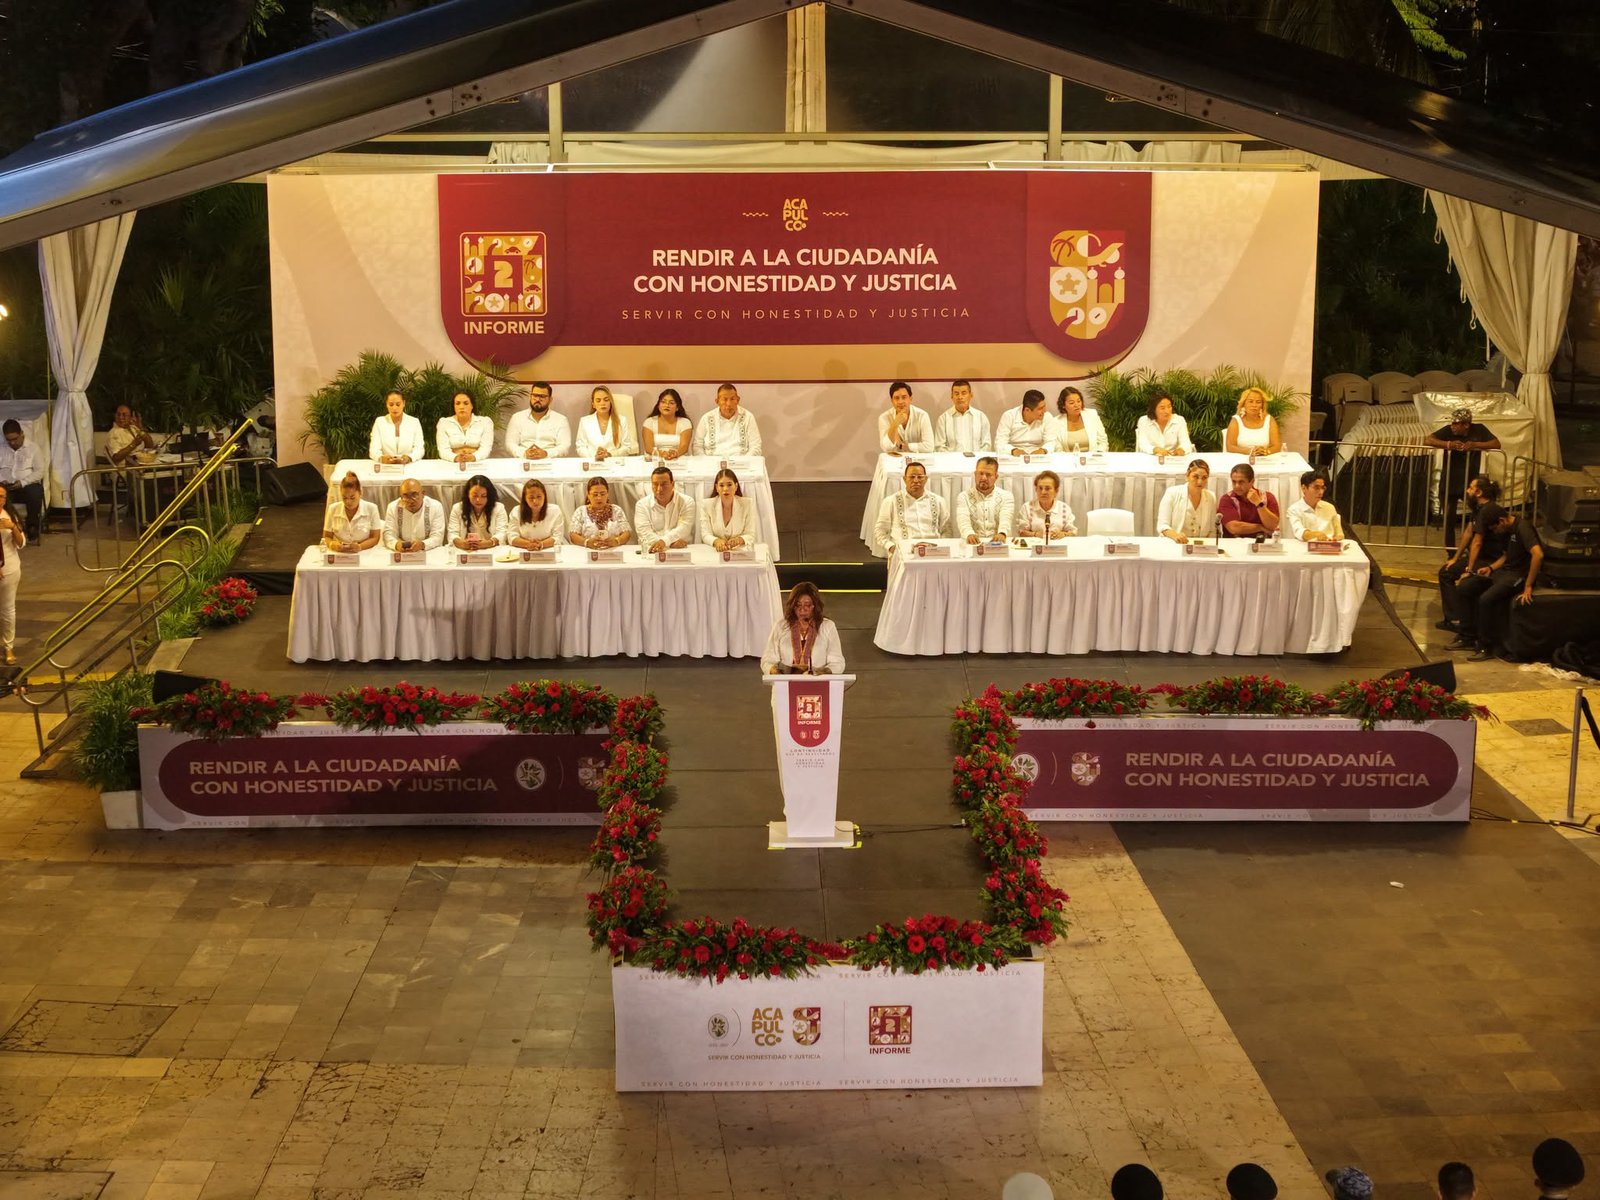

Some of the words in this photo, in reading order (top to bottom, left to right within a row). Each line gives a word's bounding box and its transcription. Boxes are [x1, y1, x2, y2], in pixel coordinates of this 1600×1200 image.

[783, 198, 808, 210] ACA
[783, 209, 808, 221] PUL
[652, 249, 734, 267] RENDIR
[740, 249, 757, 266] A
[763, 248, 790, 266] LA
[796, 243, 938, 265] CIUDADANÍA
[494, 260, 513, 288] 2
[633, 275, 683, 293] CON
[691, 274, 836, 292] HONESTIDAD
[842, 274, 857, 291] Y
[862, 273, 957, 291] JUSTICIA
[622, 309, 683, 320] SERVIR
[694, 309, 730, 319] CON
[742, 308, 858, 319] HONESTIDAD
[869, 308, 877, 318] Y
[888, 307, 970, 318] JUSTICIA
[464, 320, 545, 335] INFORME
[189, 761, 267, 775] RENDIR
[273, 760, 288, 774] A
[294, 760, 320, 773] LA
[326, 755, 461, 773] CIUDADANÍA
[1126, 753, 1204, 767] RENDIR
[1208, 753, 1224, 766] A
[1231, 753, 1256, 767] LA
[1262, 750, 1396, 767] CIUDADANÍA
[190, 780, 238, 795] CON
[245, 779, 382, 794] HONESTIDAD
[387, 779, 402, 792] Y
[407, 778, 498, 792] JUSTICIA
[1124, 772, 1172, 787] CON
[1179, 773, 1316, 787] HONESTIDAD
[1322, 773, 1336, 787] Y
[1340, 773, 1430, 787] JUSTICIA
[752, 1007, 784, 1021] ACA
[752, 1020, 784, 1034] PUL
[885, 1018, 896, 1033] 2
